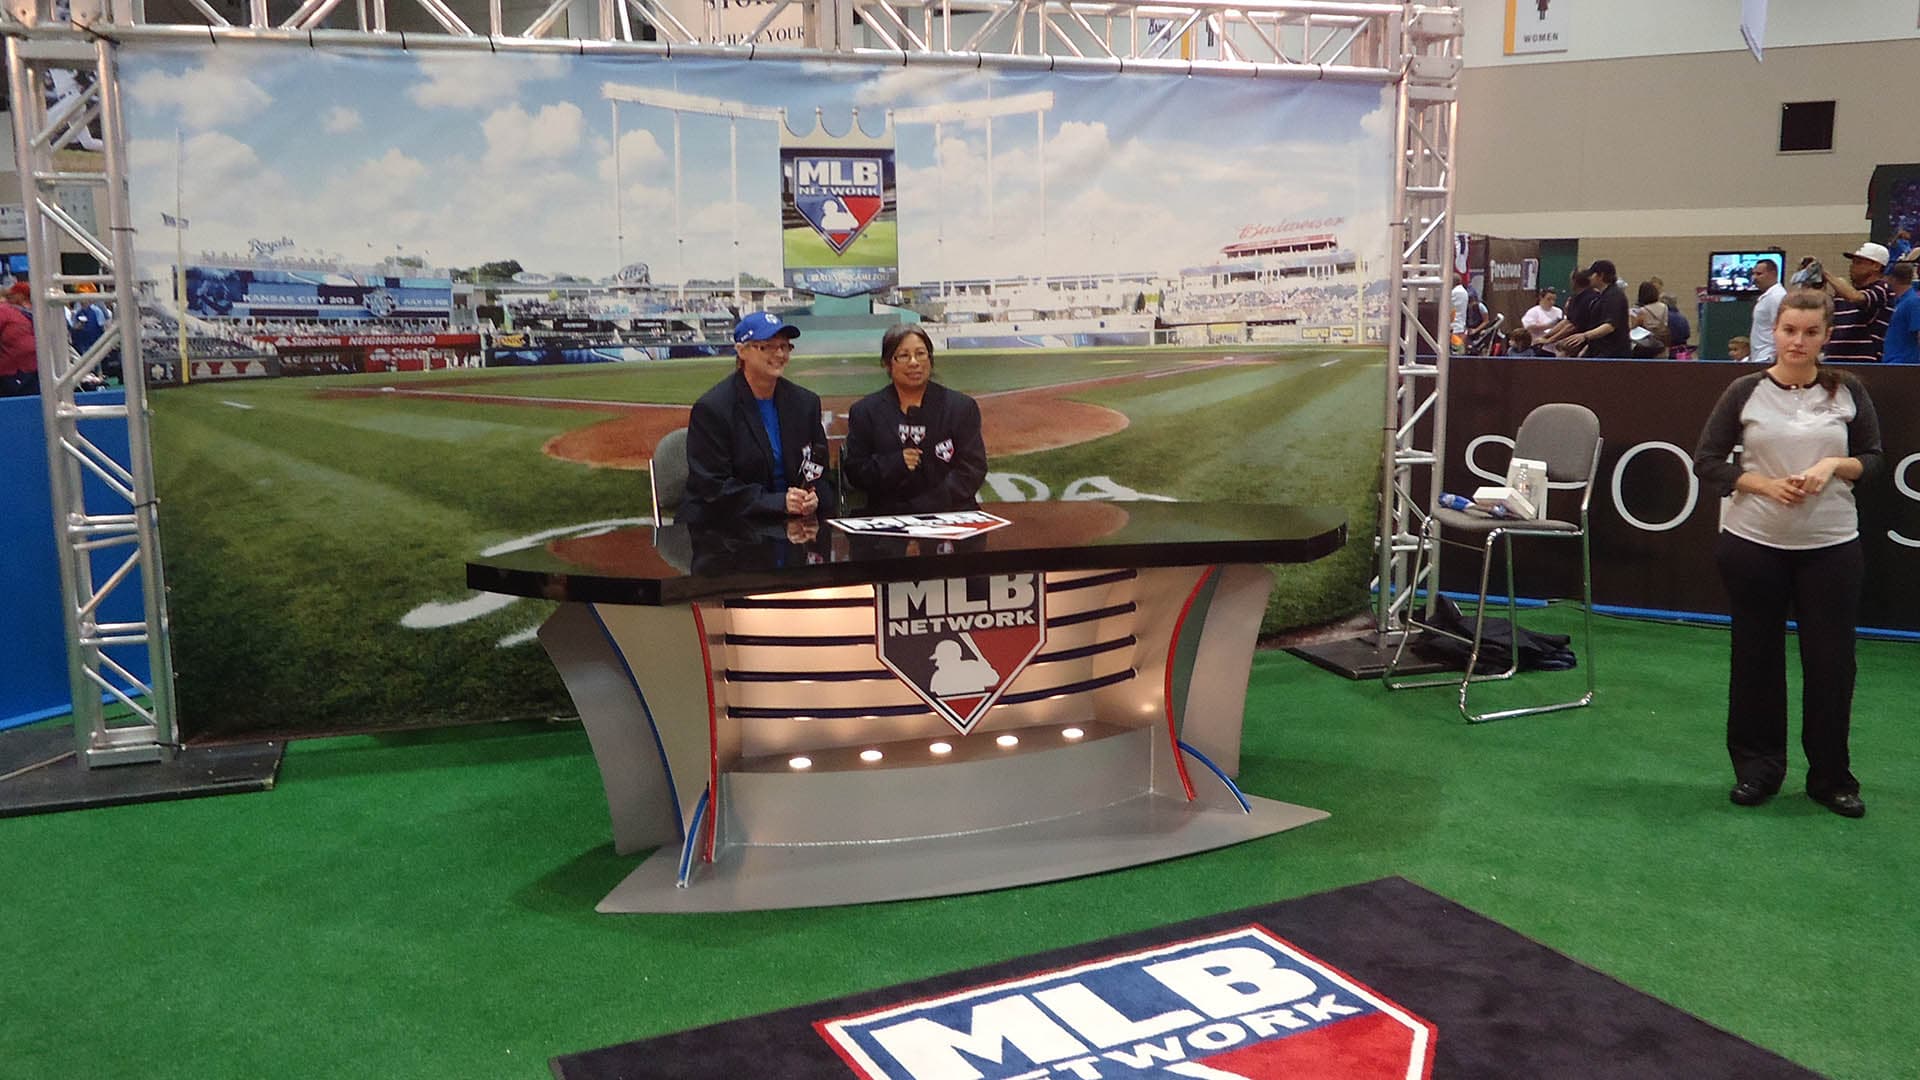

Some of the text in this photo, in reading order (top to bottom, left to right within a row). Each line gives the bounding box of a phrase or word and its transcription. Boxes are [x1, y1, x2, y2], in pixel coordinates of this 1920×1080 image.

[766, 26, 805, 42] YOUR
[1523, 32, 1559, 43] WOMEN
[799, 160, 879, 186] MLB
[800, 187, 878, 196] NETWORK
[247, 236, 296, 255] Royals
[242, 294, 356, 305] KANSAS CITY 2012
[348, 335, 436, 345] NEIGHBORHOOD
[888, 573, 1035, 619] MLB
[889, 610, 1036, 637] NETWORK
[868, 947, 1318, 1080] MLB
[998, 994, 1363, 1080] TWORK
